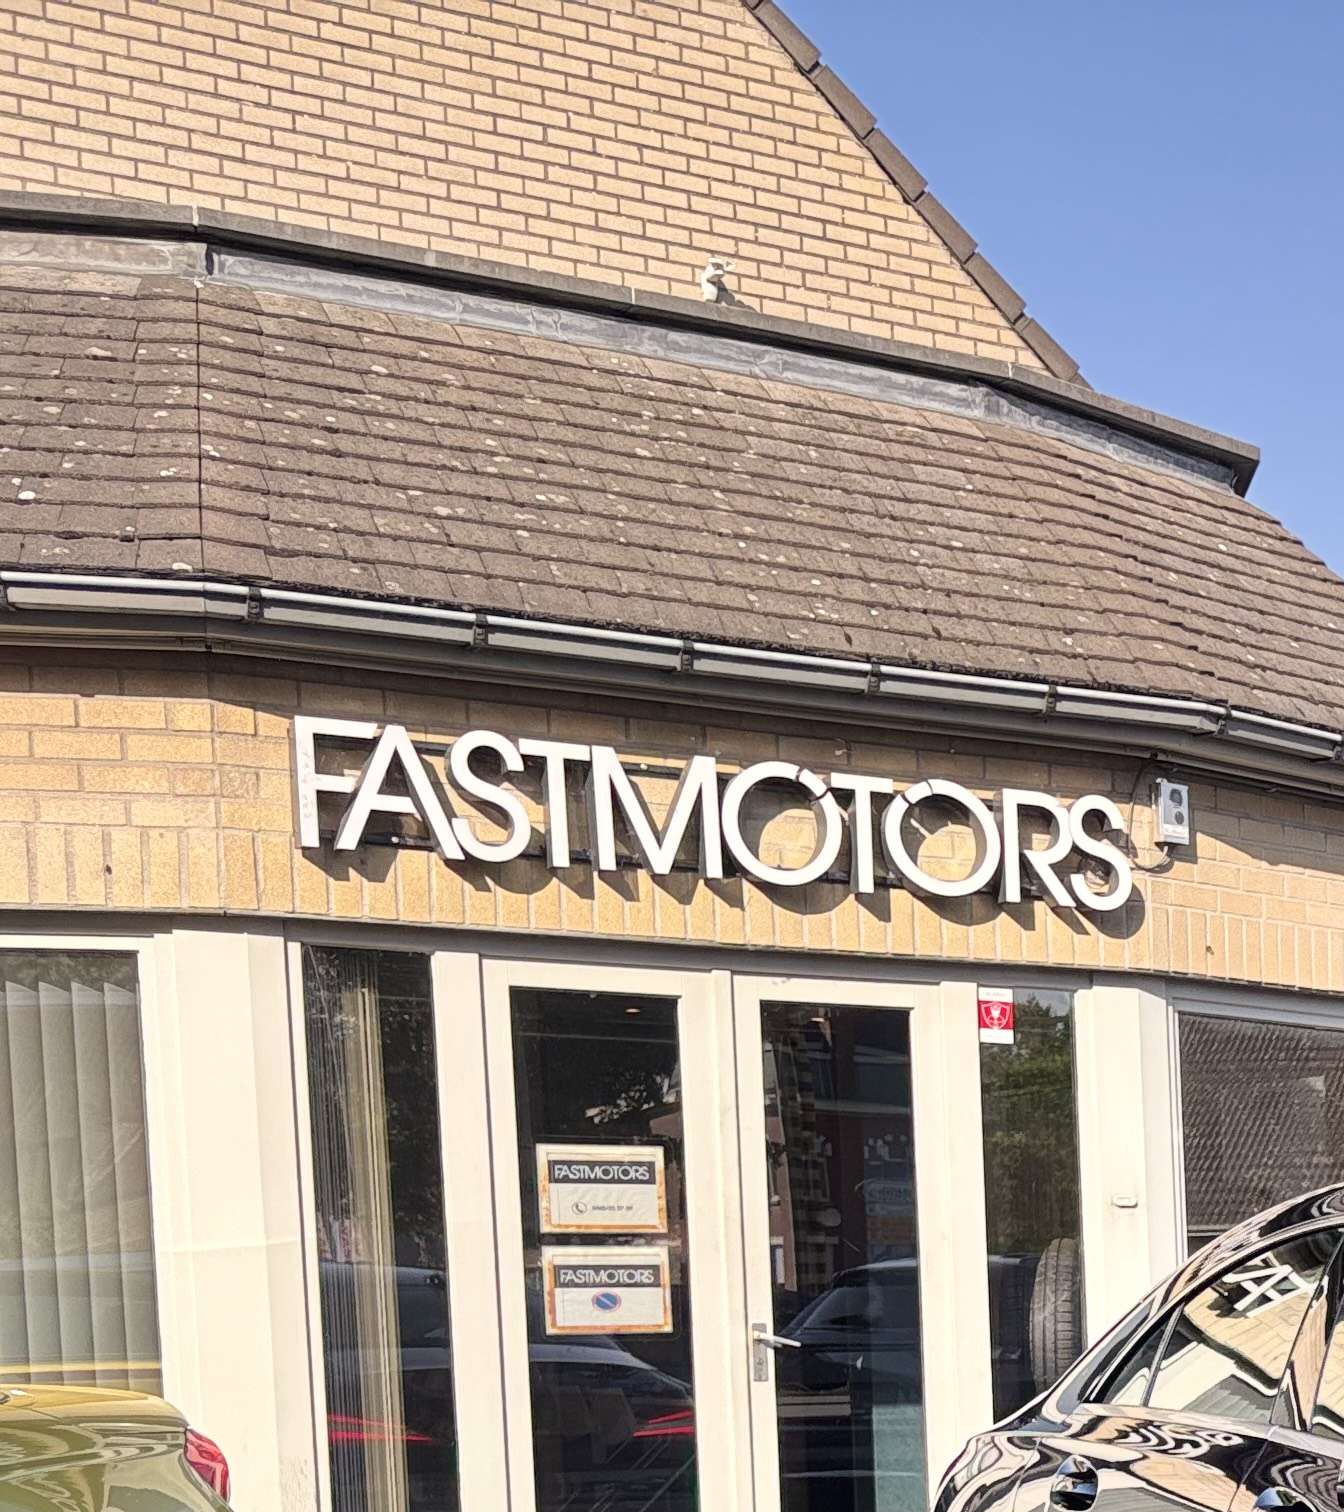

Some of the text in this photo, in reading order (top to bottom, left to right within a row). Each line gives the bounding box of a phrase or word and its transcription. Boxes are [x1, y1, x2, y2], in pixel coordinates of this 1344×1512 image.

[292, 714, 1134, 913] FASTMOTORS
[553, 1163, 650, 1181] FASTMOTORS
[559, 1268, 655, 1285] FASTMOTORS
